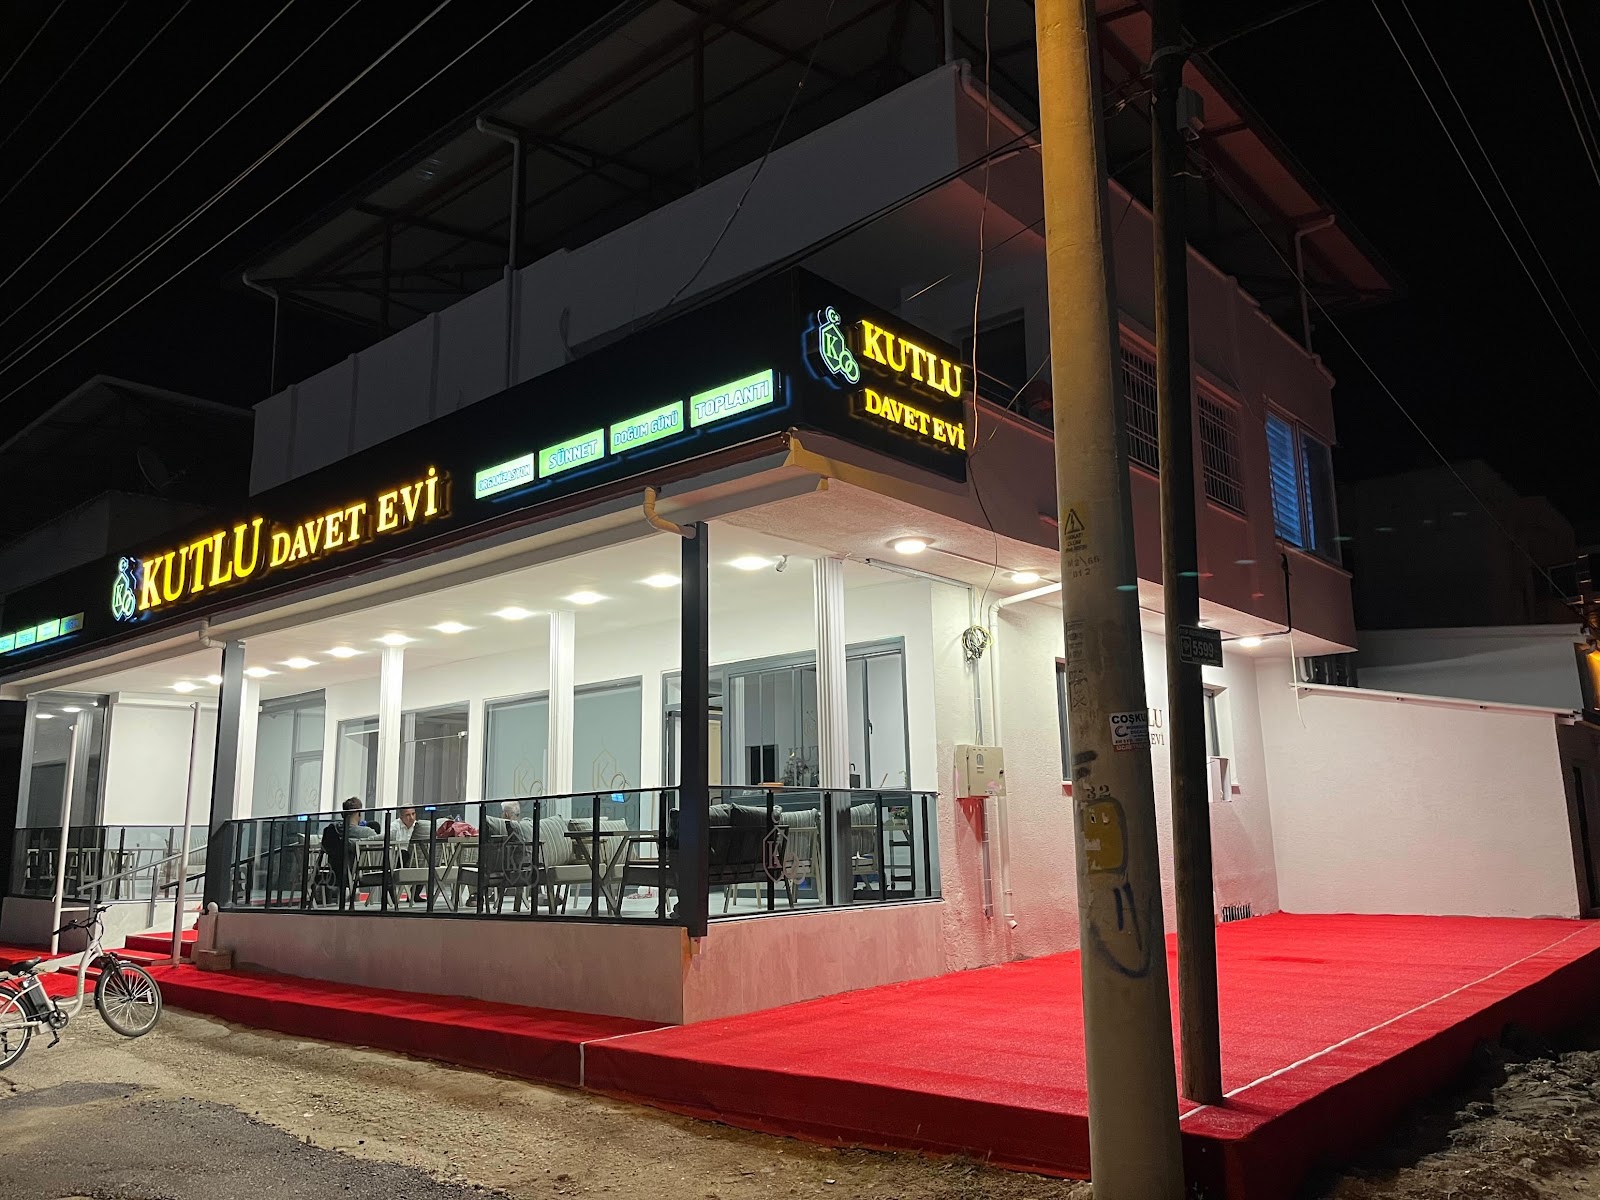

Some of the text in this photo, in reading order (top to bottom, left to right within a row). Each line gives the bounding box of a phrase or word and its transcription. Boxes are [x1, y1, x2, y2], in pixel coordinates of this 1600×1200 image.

[861, 319, 962, 398] KUTLU
[694, 379, 770, 420] TOPLANTI
[864, 387, 966, 451] DAVET EVİ
[613, 409, 679, 447] DOĞUM GÜNÜ
[548, 439, 598, 470] SÜNNET
[477, 463, 531, 492] ORGANİZASYON
[138, 465, 440, 612] KUTLU DAVET EVİ
